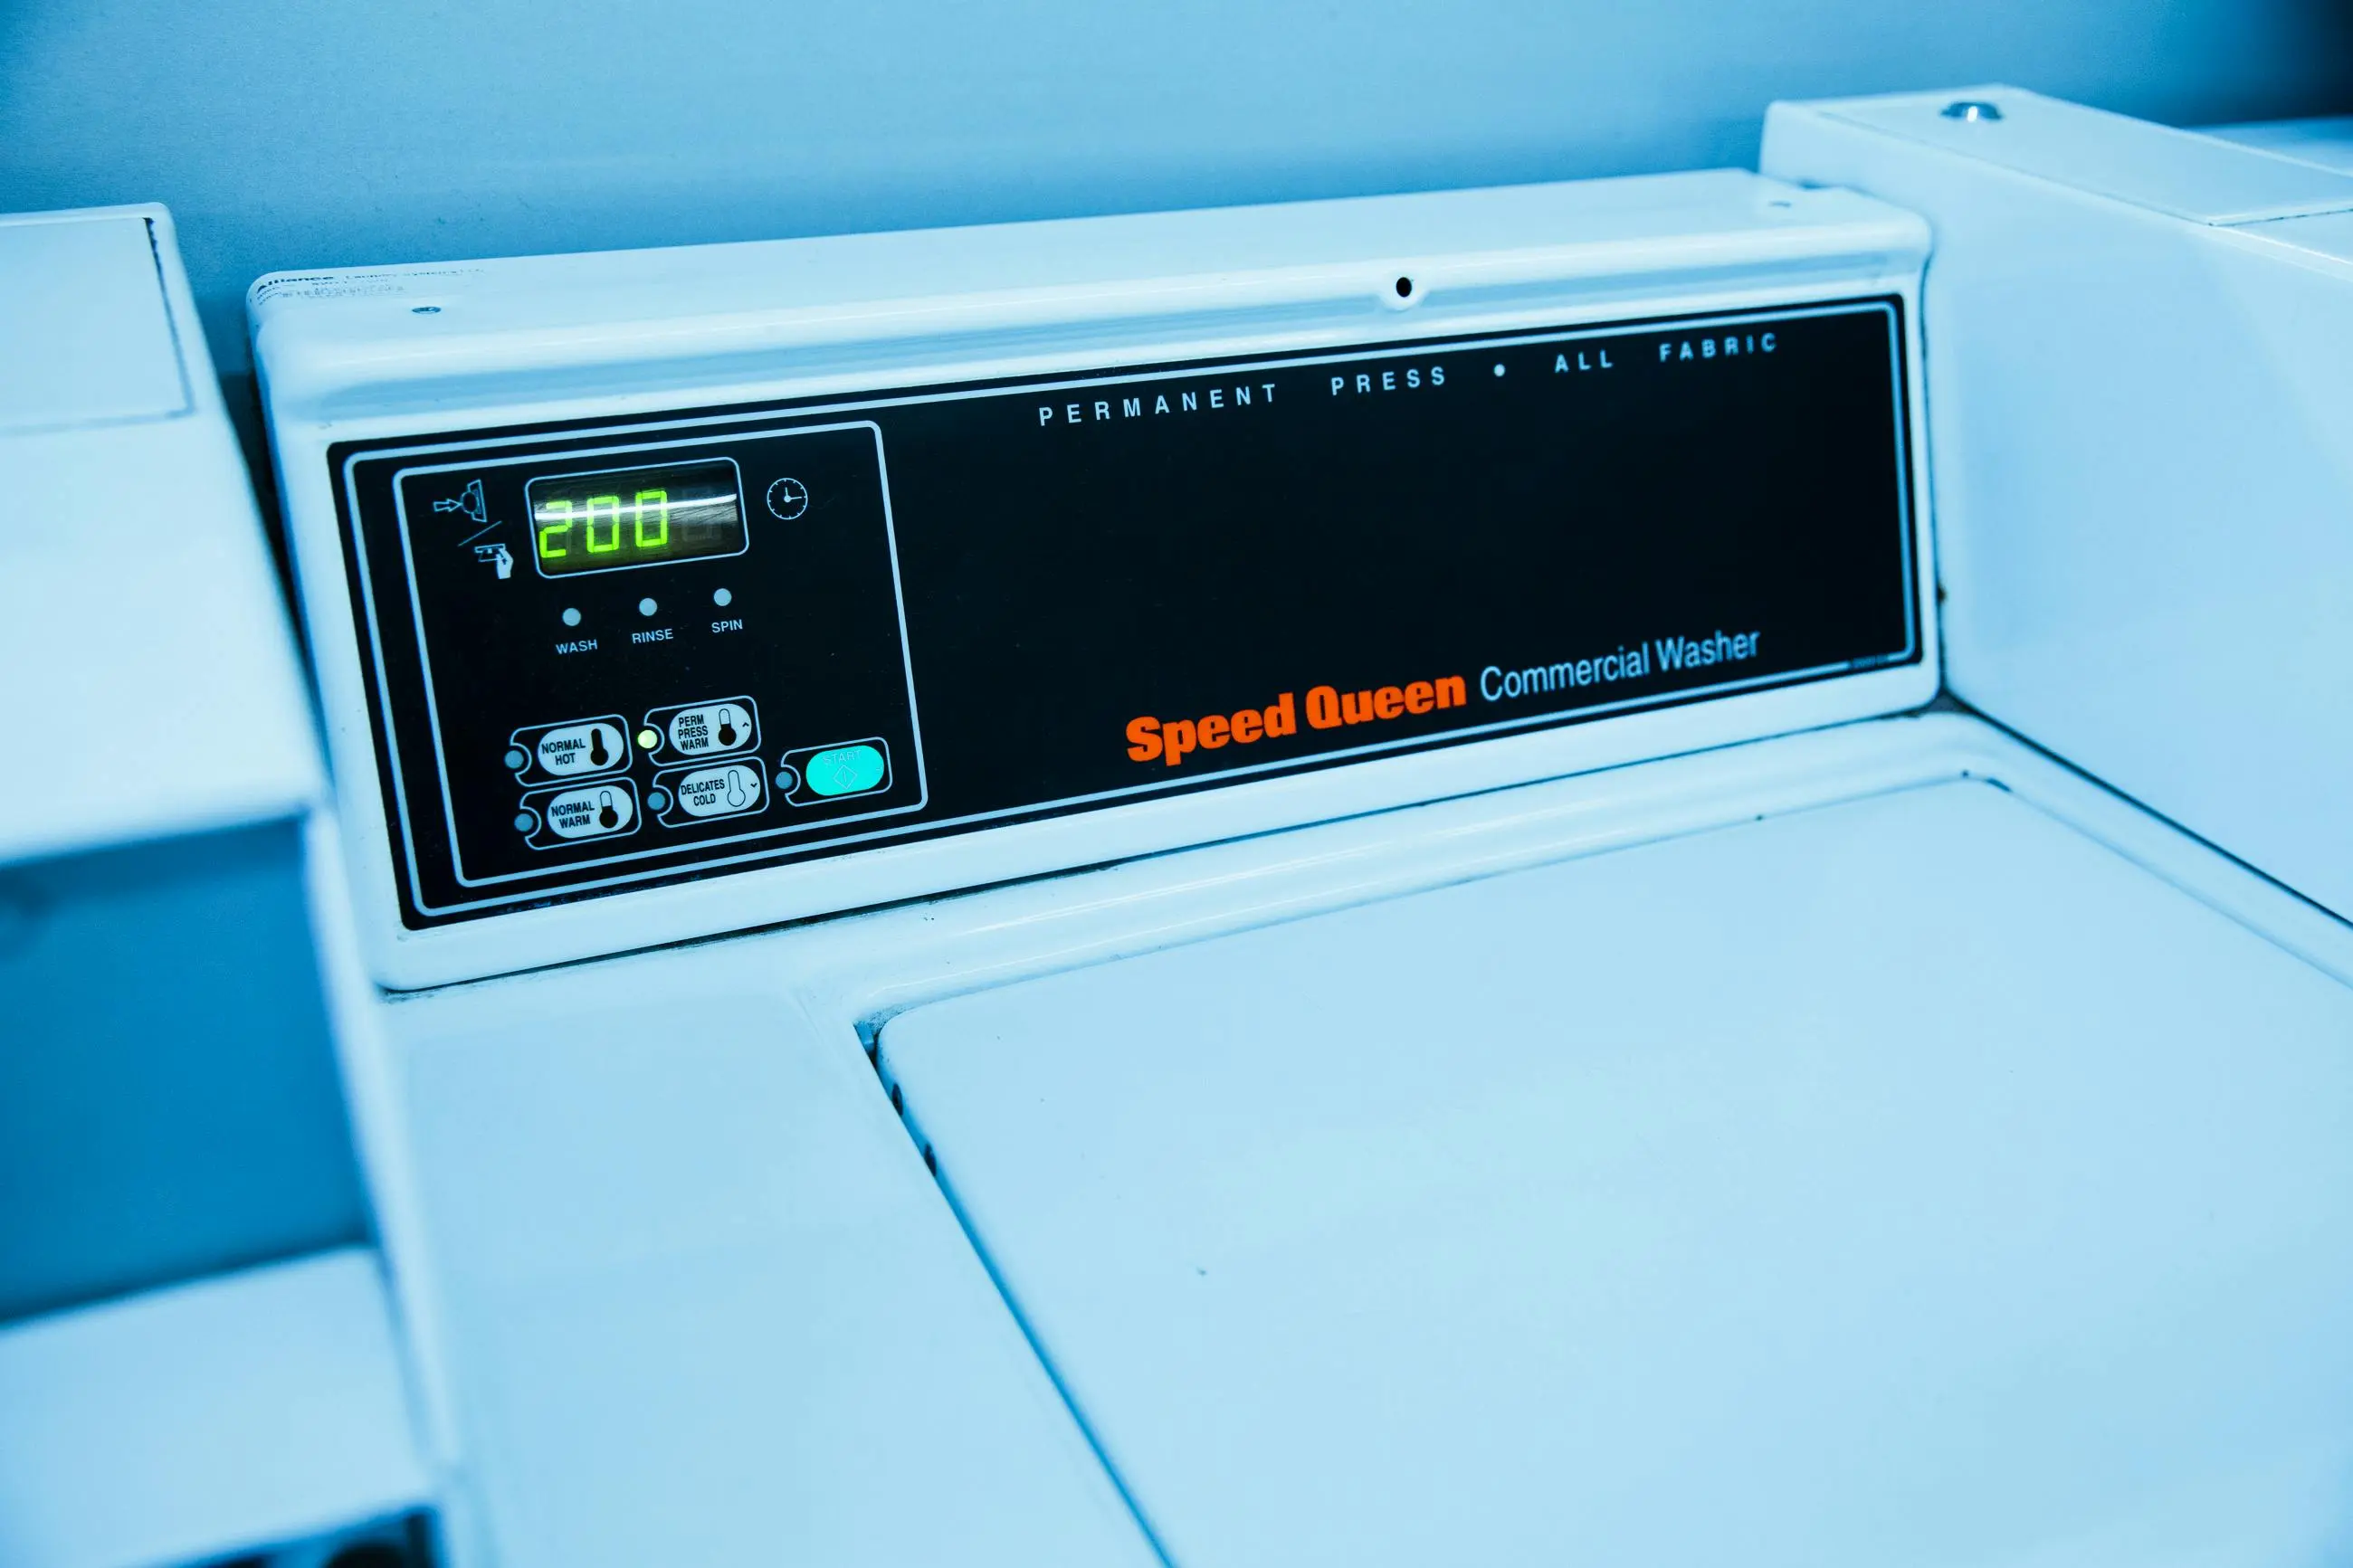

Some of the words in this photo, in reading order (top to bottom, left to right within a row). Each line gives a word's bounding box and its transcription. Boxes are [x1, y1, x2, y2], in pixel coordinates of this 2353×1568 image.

[1038, 383, 1276, 427] PERMANENT
[1330, 366, 1445, 396] PRESS
[1554, 349, 1614, 374] ALL
[1659, 332, 1777, 362] FABRIC
[538, 489, 669, 559] 200
[711, 619, 743, 633] SPIN
[631, 628, 674, 645] RINSE
[555, 639, 598, 655] WASH
[1125, 692, 1297, 767] Speed
[1305, 674, 1467, 730] Queen
[1480, 641, 1651, 702] Commercial
[1654, 630, 1760, 672] Washer
[678, 714, 705, 727] PERM
[678, 725, 709, 739] PRESS
[541, 738, 586, 755] NORMAL
[680, 737, 709, 751] WARM
[555, 752, 576, 765] HOT
[823, 749, 862, 766] START
[681, 778, 725, 795] DELICATES
[693, 793, 717, 806] COLD
[550, 801, 595, 817] NORMAL
[558, 814, 591, 829] WARM
